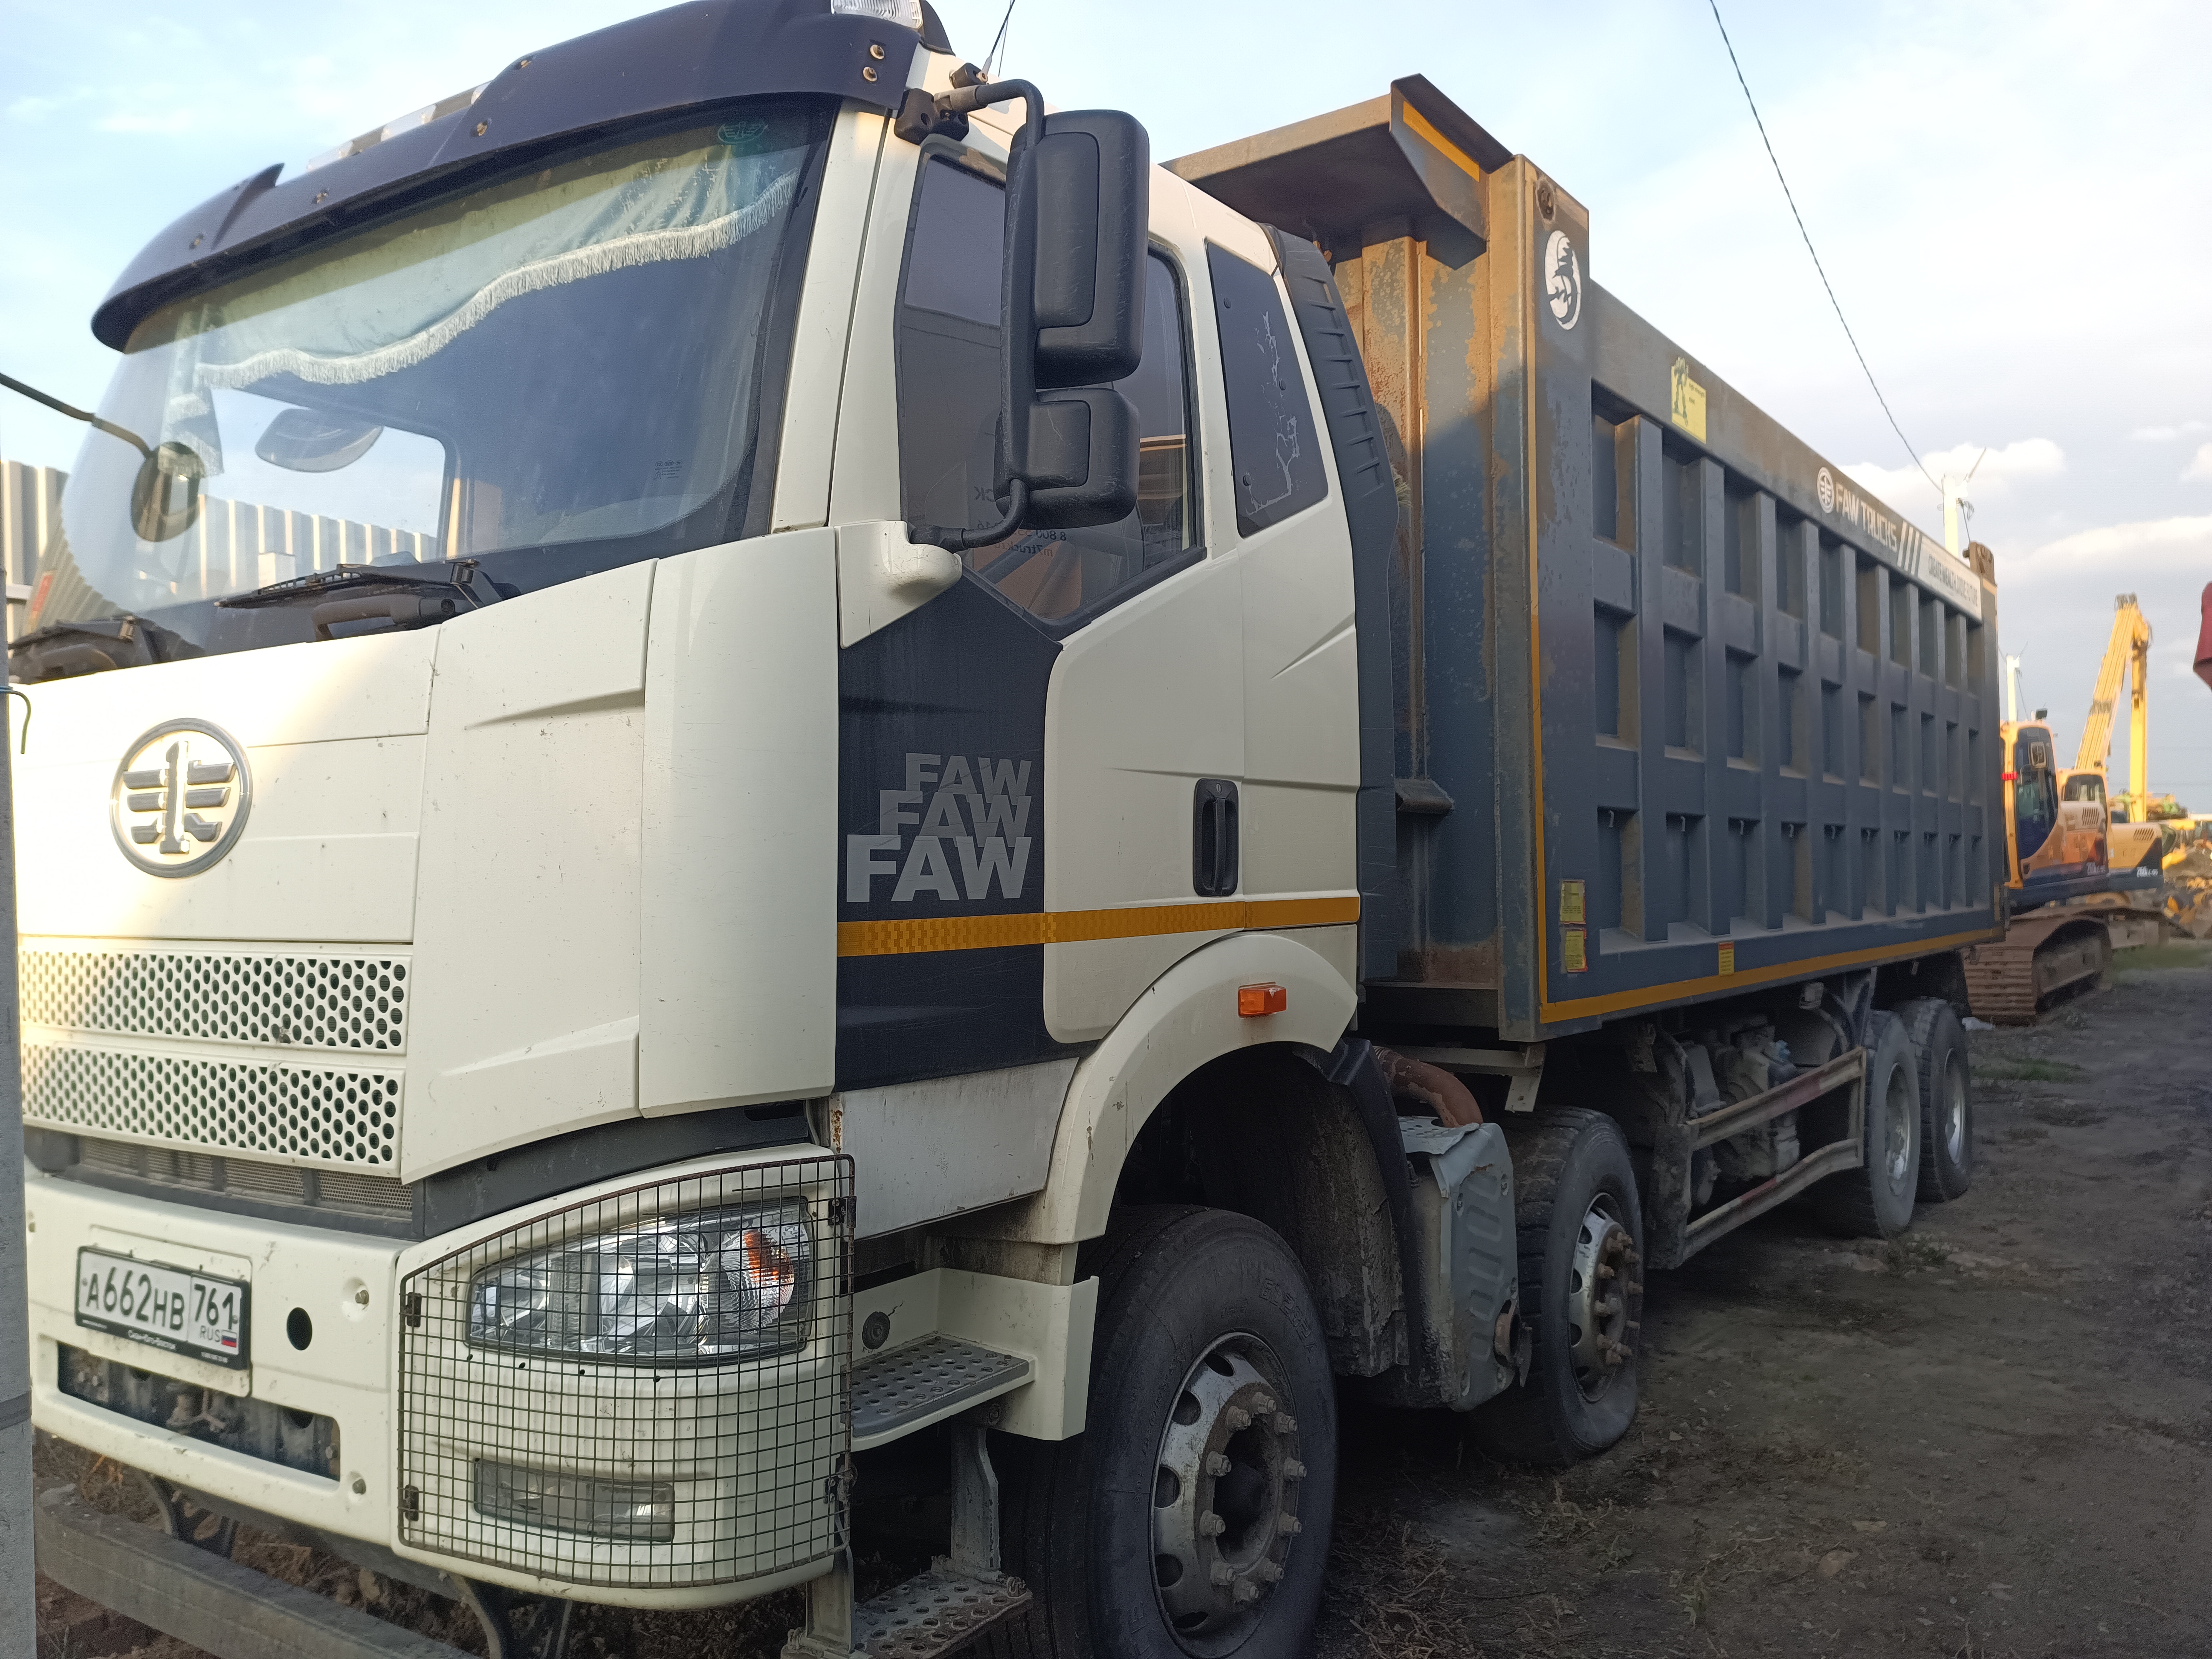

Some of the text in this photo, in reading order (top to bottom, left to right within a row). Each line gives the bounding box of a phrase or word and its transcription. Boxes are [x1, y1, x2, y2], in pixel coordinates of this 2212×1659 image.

[1836, 482, 1897, 553] FAW TRUCKS
[906, 752, 1032, 805] FAW
[880, 790, 1032, 847] FAW
[846, 834, 1032, 902] FAW
[194, 1283, 234, 1330] 761
[200, 1325, 220, 1343] RUS
